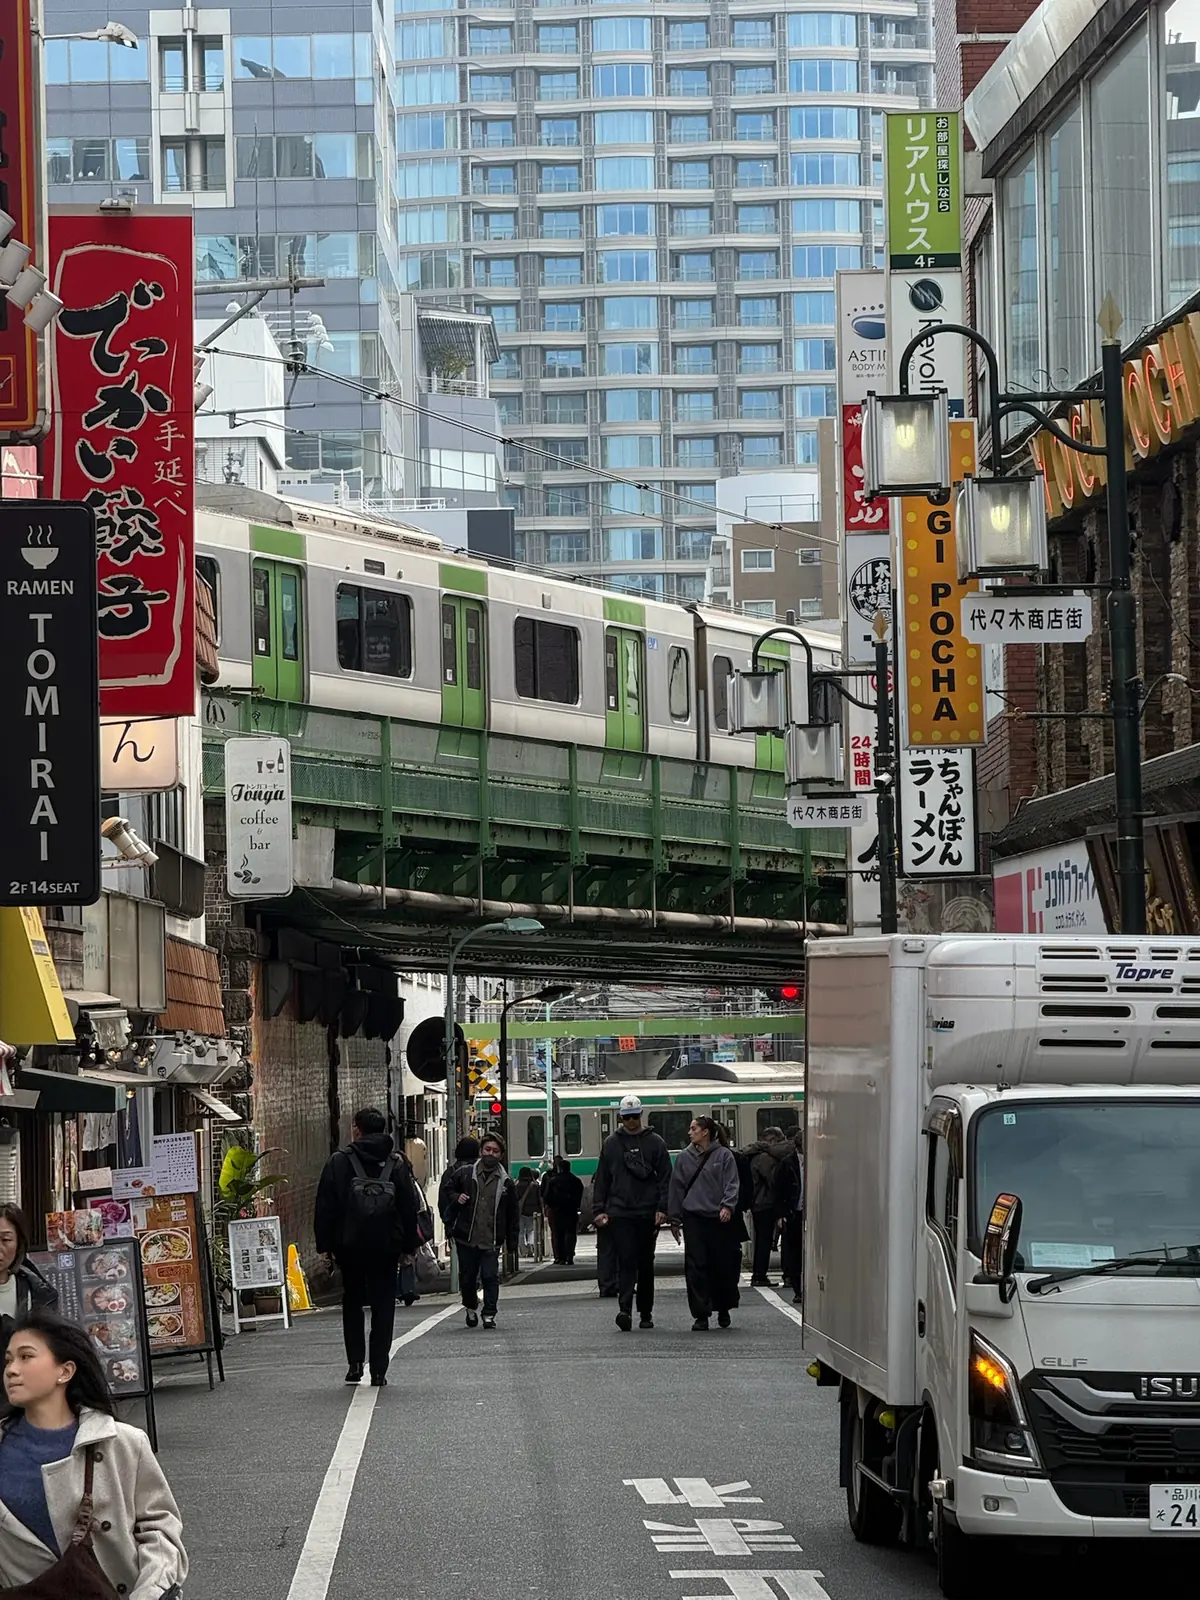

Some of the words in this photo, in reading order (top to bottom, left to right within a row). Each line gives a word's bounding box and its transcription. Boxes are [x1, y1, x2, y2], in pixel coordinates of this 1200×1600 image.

[936, 117, 950, 212] お部屋探しなら
[906, 117, 931, 250] リアハウス
[914, 255, 936, 268] 4F
[852, 363, 876, 371] BODY
[153, 420, 187, 516] 手延べ
[7, 580, 74, 595] RAMEN
[875, 562, 891, 609] 木村屋
[970, 607, 1083, 632] 代々木商店街
[929, 583, 957, 721] POCHA
[24, 613, 60, 861] TOMIRAI
[851, 736, 872, 786] 24時間
[240, 809, 279, 825] coffee
[792, 805, 863, 820] 代々木商店街
[908, 759, 936, 867] ラーメン
[938, 758, 966, 866] ちゃんぽん
[249, 835, 271, 850] bar
[10, 882, 28, 894] 2F
[1115, 963, 1174, 981] Topre
[1040, 1357, 1088, 1368] ELF
[1140, 1377, 1198, 1398] ISU
[1171, 1487, 1200, 1501] 品川
